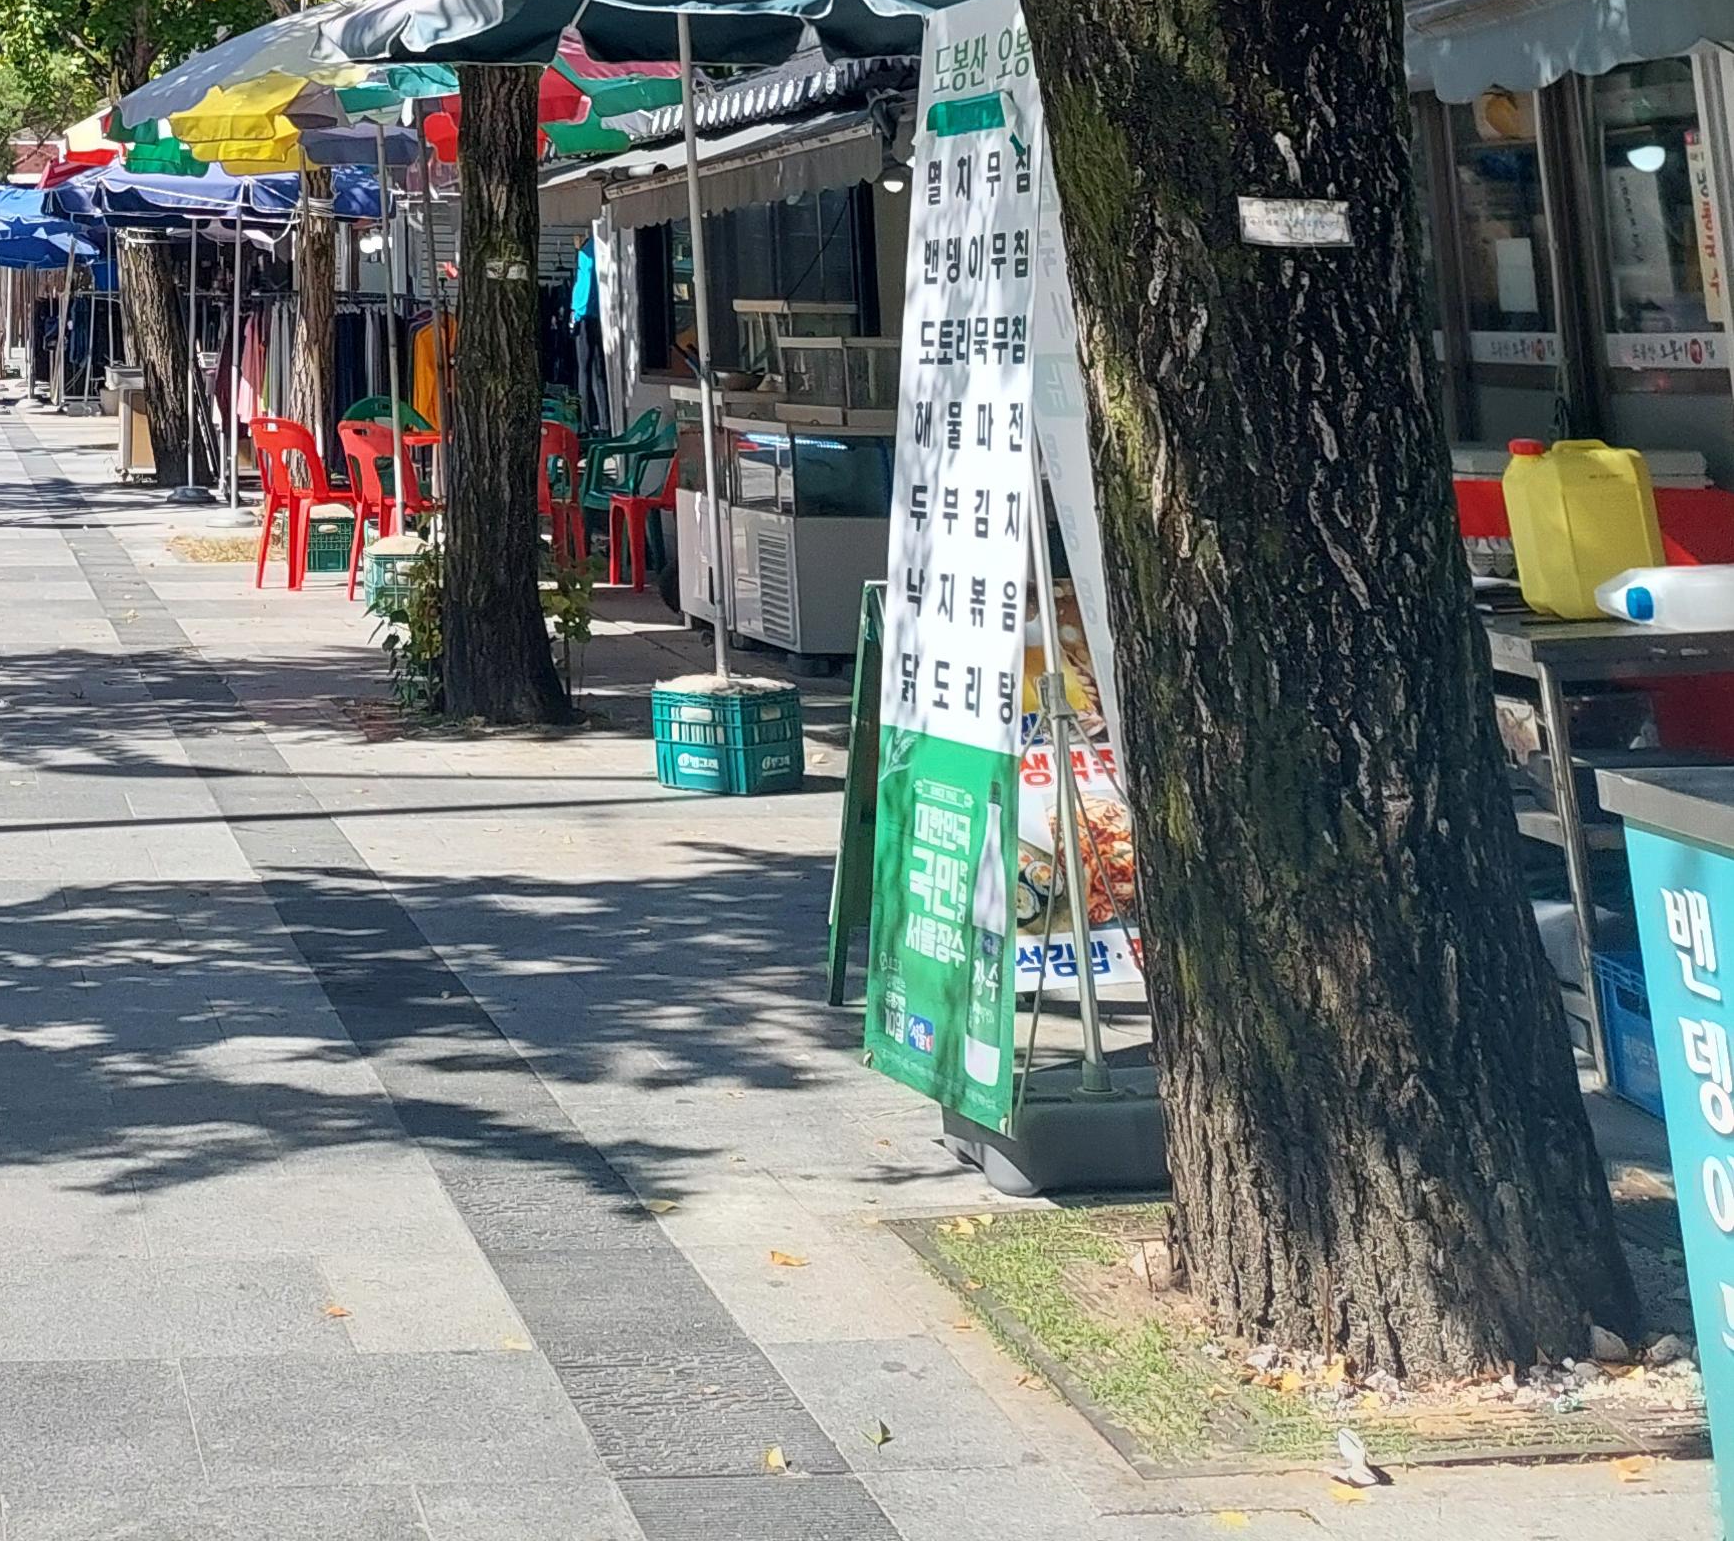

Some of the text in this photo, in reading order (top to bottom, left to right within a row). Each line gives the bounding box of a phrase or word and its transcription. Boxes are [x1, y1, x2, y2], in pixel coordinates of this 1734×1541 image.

[933, 33, 988, 94] 도봉산
[928, 144, 1031, 206] 멸치무침
[919, 315, 1027, 365] 도토리묵무침
[915, 401, 1024, 452] 해물파전
[909, 484, 1021, 542] 두부김치
[906, 567, 1017, 633] 낙지볶음
[901, 653, 1015, 725] 닭도리탕
[909, 845, 958, 920] 국민
[905, 912, 966, 968] 서울장수
